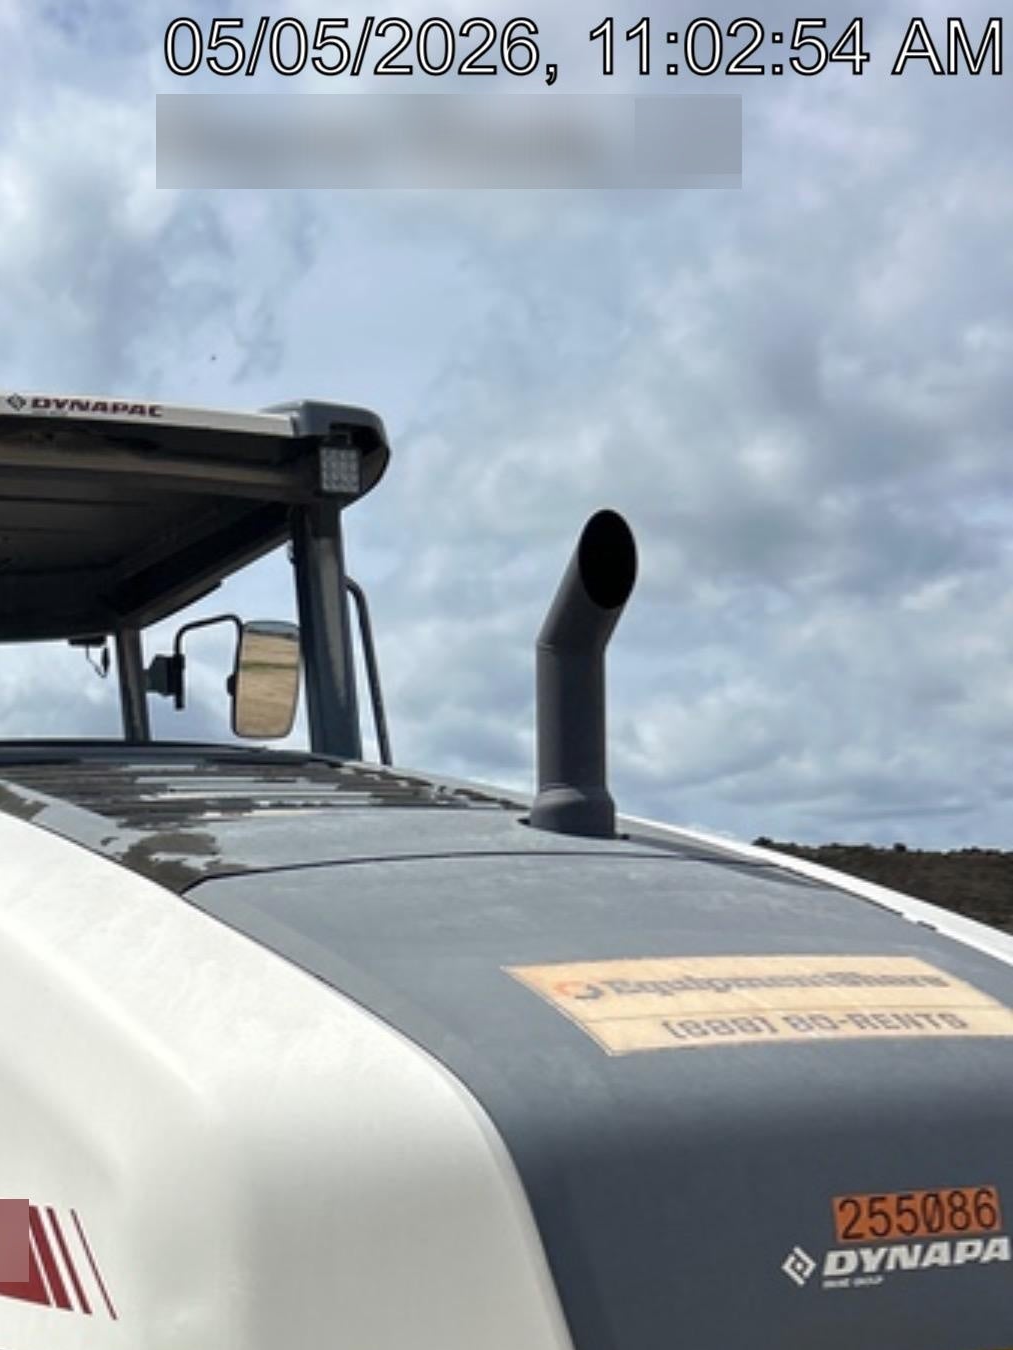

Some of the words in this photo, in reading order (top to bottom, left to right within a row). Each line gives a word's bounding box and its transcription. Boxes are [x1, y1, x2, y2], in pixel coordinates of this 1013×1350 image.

[31, 397, 164, 418] DYNAPAC
[838, 1187, 997, 1240] 255086
[822, 1236, 1012, 1277] DYNAPA
